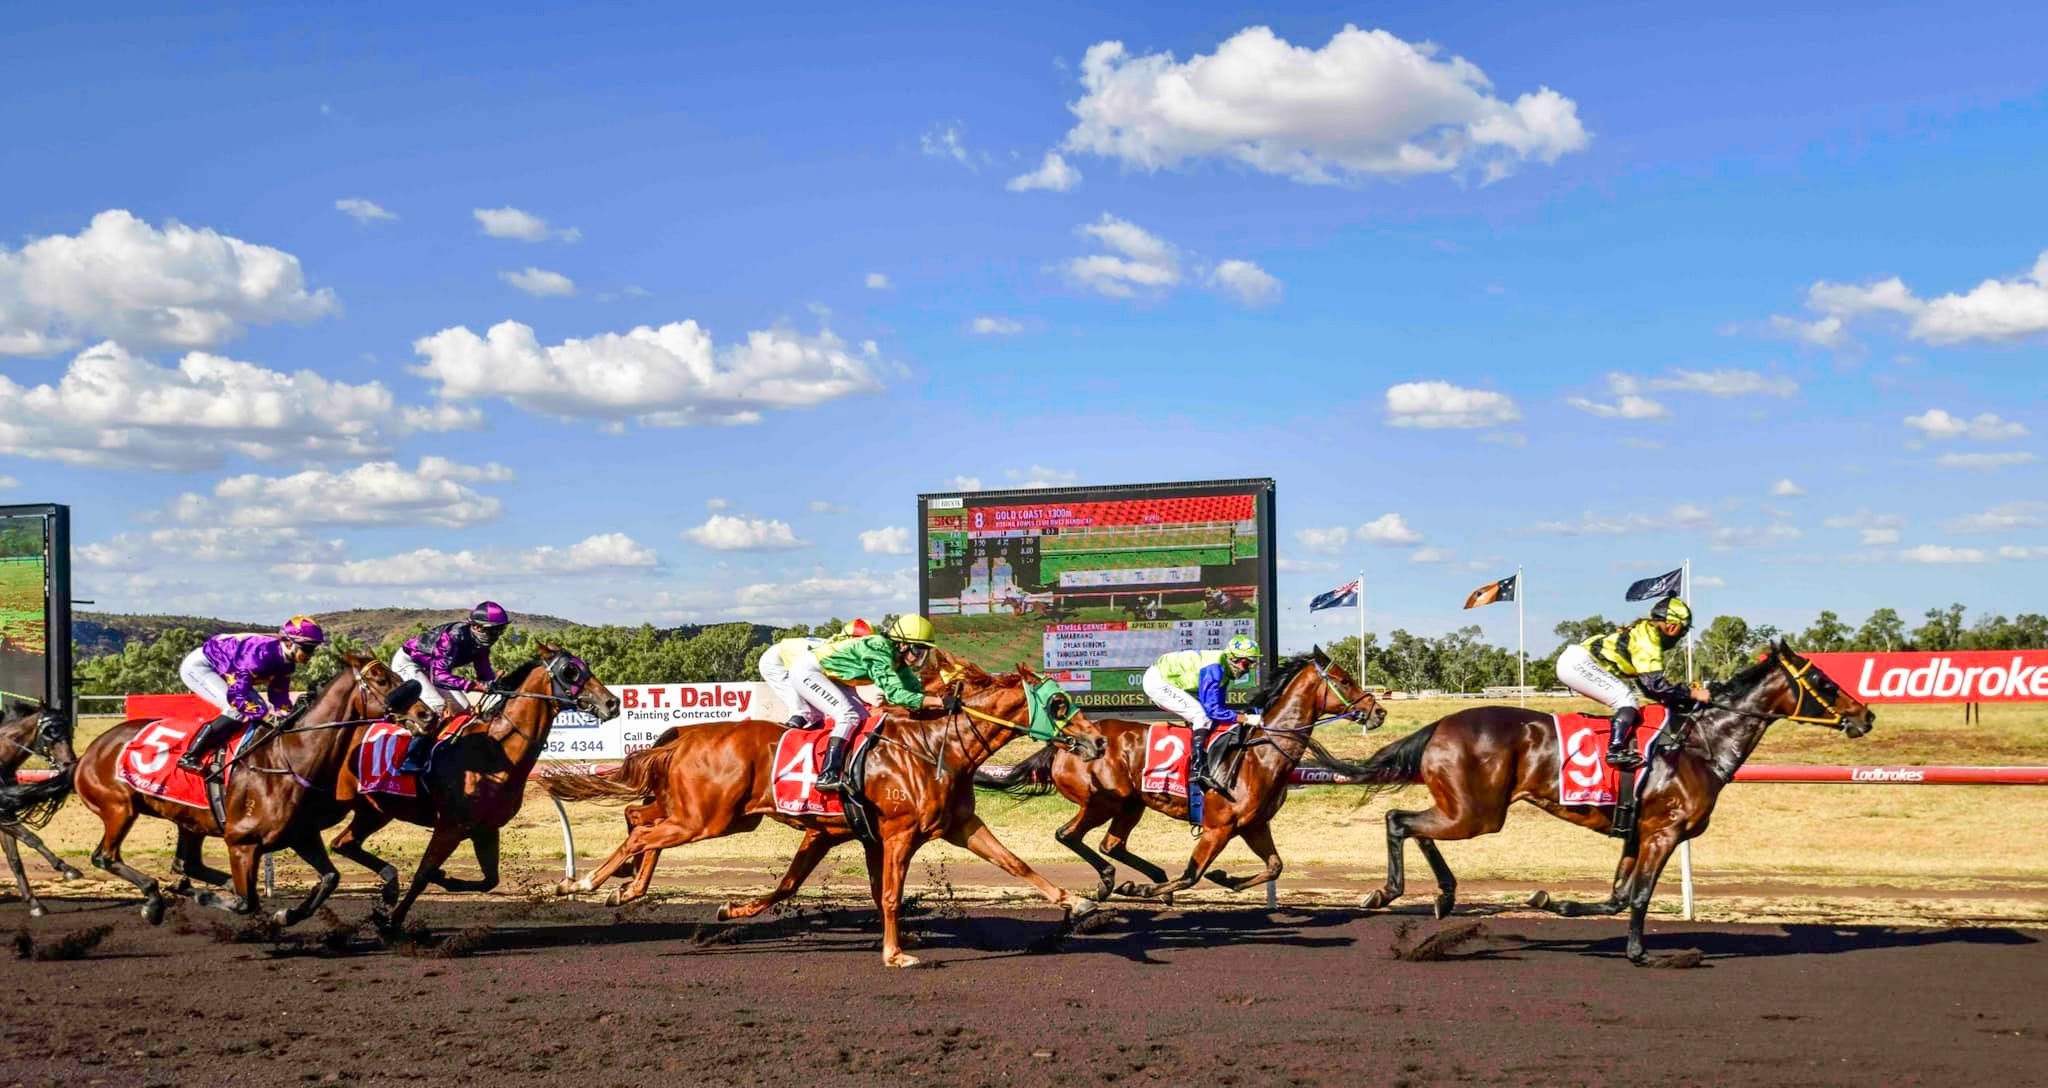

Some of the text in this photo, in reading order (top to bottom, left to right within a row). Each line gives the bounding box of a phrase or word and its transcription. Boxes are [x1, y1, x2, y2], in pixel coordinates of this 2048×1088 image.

[974, 511, 984, 529] 8
[995, 509, 1072, 520] GOLD COAST 1300m
[623, 685, 752, 713] B.T. Daley
[1075, 694, 1145, 705] ADBROKES
[627, 710, 732, 721] Painting Contractor
[624, 732, 643, 741] Call
[130, 725, 187, 774] 5
[571, 740, 604, 752] 4344
[1154, 735, 1184, 779] 2
[1567, 727, 1603, 786] 9
[778, 742, 818, 799] 4
[1851, 767, 1924, 781] Ladbrokes
[885, 788, 907, 801] 103
